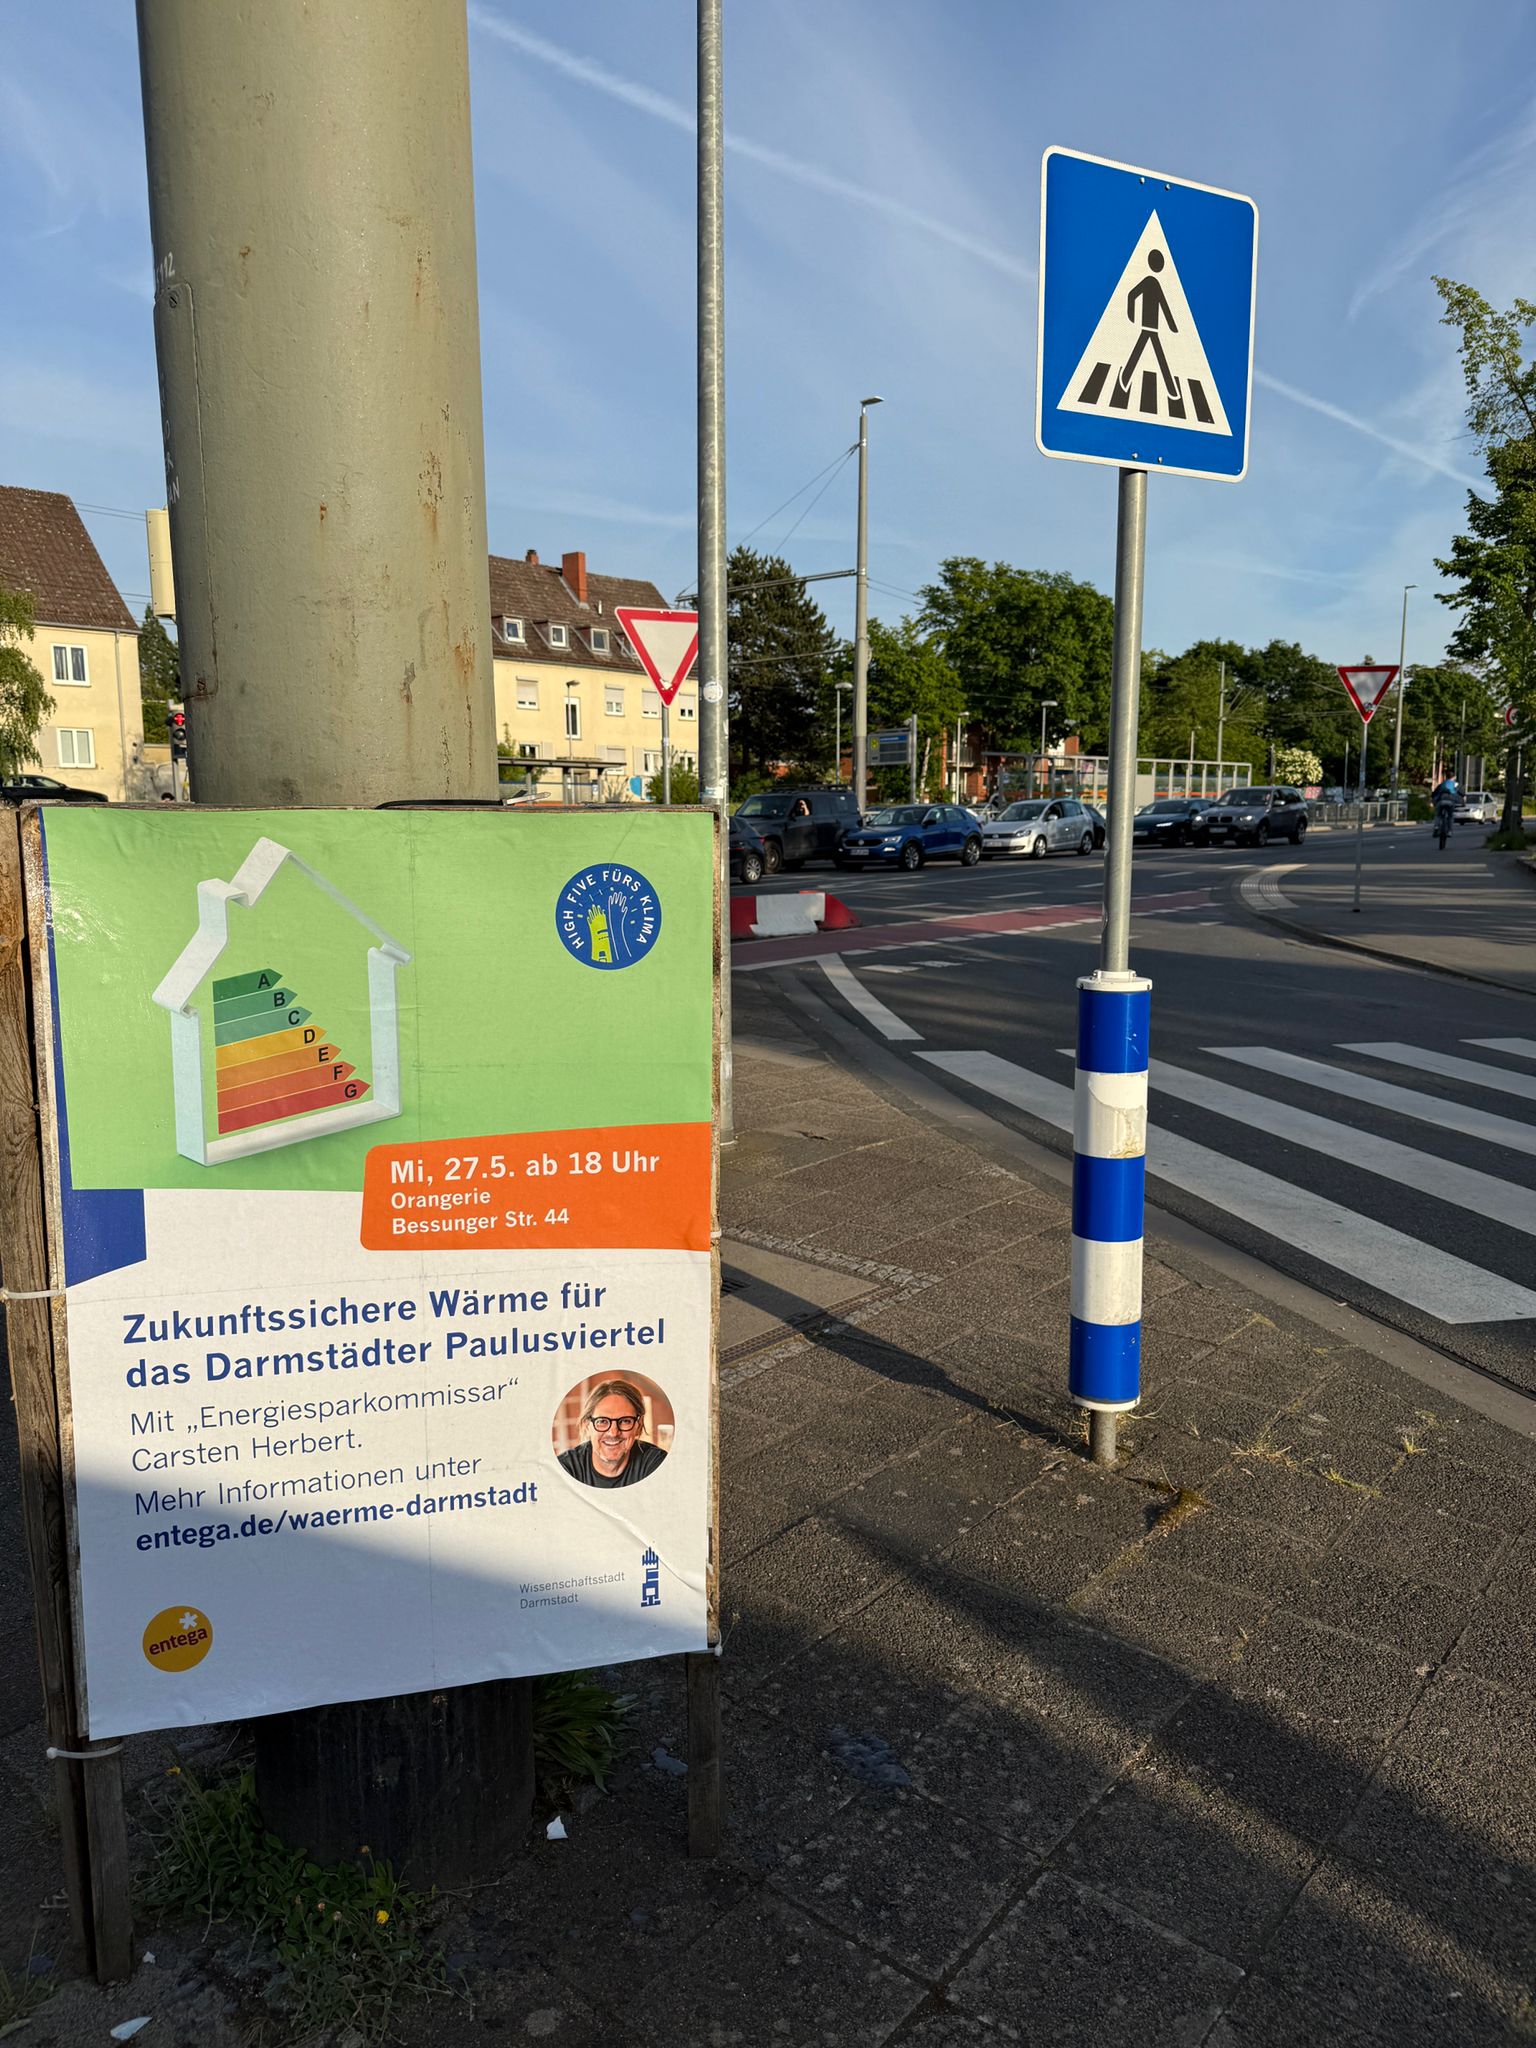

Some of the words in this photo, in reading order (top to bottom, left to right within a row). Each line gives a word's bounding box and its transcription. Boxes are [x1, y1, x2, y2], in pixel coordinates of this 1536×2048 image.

[567, 874, 596, 903] FIVE
[603, 868, 641, 892] FÜRS
[563, 910, 584, 949] HIGH
[636, 895, 655, 944] KLIMA
[258, 973, 270, 989] A
[273, 991, 286, 1007] B
[288, 1010, 300, 1025] C
[304, 1029, 316, 1044] D
[318, 1047, 329, 1062] E
[333, 1065, 343, 1081] F
[344, 1083, 358, 1099] G
[390, 1159, 434, 1186] Mi,
[444, 1155, 516, 1181] 27.5.
[525, 1153, 558, 1177] ab
[568, 1151, 602, 1175] 18
[611, 1150, 660, 1173] Uhr
[391, 1188, 491, 1210] Orangerie
[392, 1214, 498, 1235] Bessunger
[505, 1210, 537, 1228] Str.
[544, 1208, 570, 1225] 44
[122, 1296, 417, 1344] Zukunftssichere
[429, 1289, 548, 1318] Wärme
[560, 1281, 607, 1309] für
[126, 1358, 191, 1388] das
[206, 1338, 432, 1381] Darmstädter
[446, 1318, 665, 1360] Paulusviertel
[131, 1410, 174, 1436] Mit
[132, 1443, 239, 1472] Carsten
[252, 1429, 363, 1459] Herbert.
[135, 1487, 206, 1516] Mehr
[218, 1467, 404, 1505] Informationen
[416, 1456, 482, 1480] unter
[136, 1481, 538, 1551] entega.de/waerme-darmstadt
[519, 1571, 625, 1594] Wissenschaftsstadt
[520, 1593, 579, 1610] Darmstadt
[149, 1628, 208, 1656] entega
